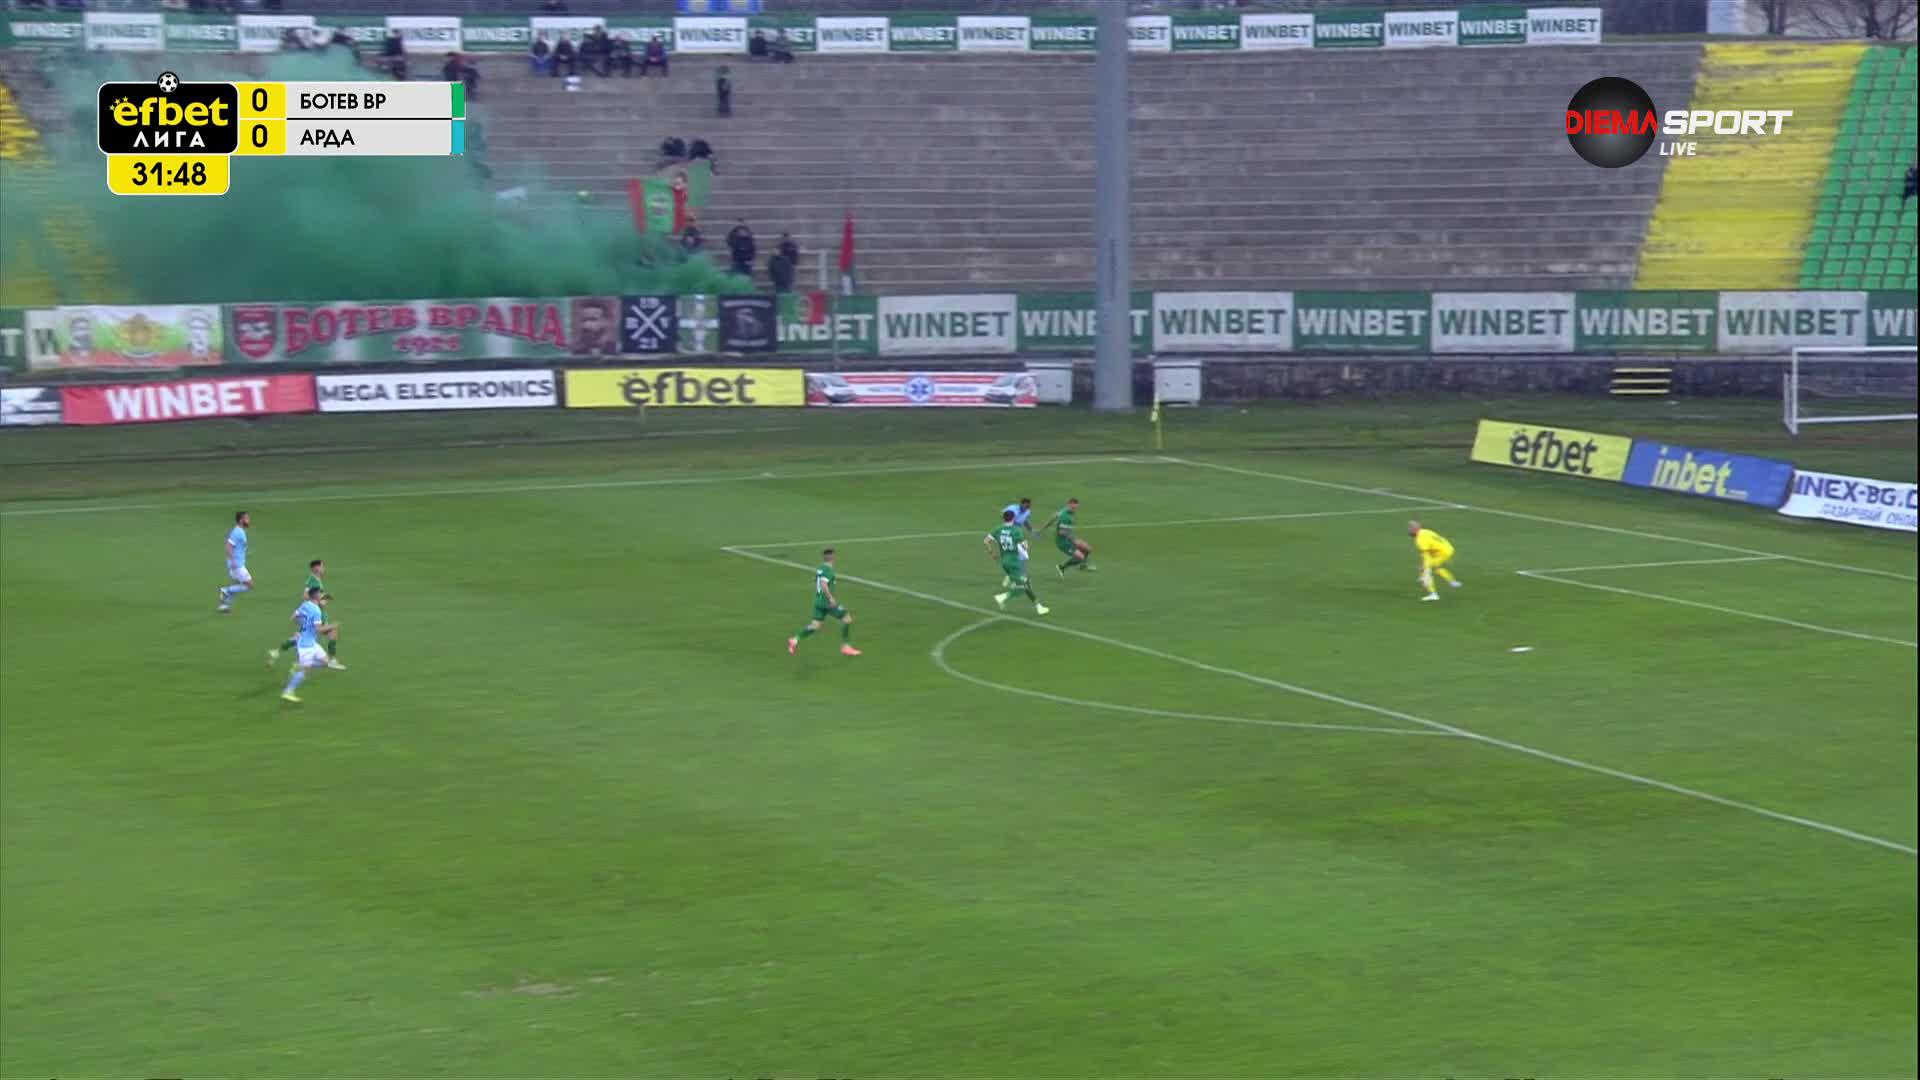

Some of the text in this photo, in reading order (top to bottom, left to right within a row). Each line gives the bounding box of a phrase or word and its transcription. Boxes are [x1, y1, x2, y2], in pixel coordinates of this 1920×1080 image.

[822, 28, 885, 42] WINBET
[1031, 27, 1098, 41] WINBET
[1173, 25, 1240, 40] WINBET
[1245, 24, 1310, 39] WINBET
[1316, 22, 1382, 38] WINBET
[1388, 21, 1455, 37] WINBET
[1460, 19, 1527, 36] WINBET
[1531, 18, 1598, 33] WINBET
[283, 302, 570, 358] БОТЕВ ВРАЦА
[776, 313, 874, 342] INBET
[884, 311, 1011, 338] WINBET
[1159, 308, 1287, 335] WINBET
[1297, 308, 1428, 337] WINBET
[1438, 308, 1570, 337] WINBET
[1579, 308, 1714, 337] WINBET
[1724, 308, 1862, 337] WINBET
[106, 379, 269, 421] WINBET
[319, 378, 554, 403] MEGA ELECTRONICS
[620, 371, 756, 406] efbet
[1509, 429, 1598, 475] efbet
[1650, 445, 1734, 499] inbet
